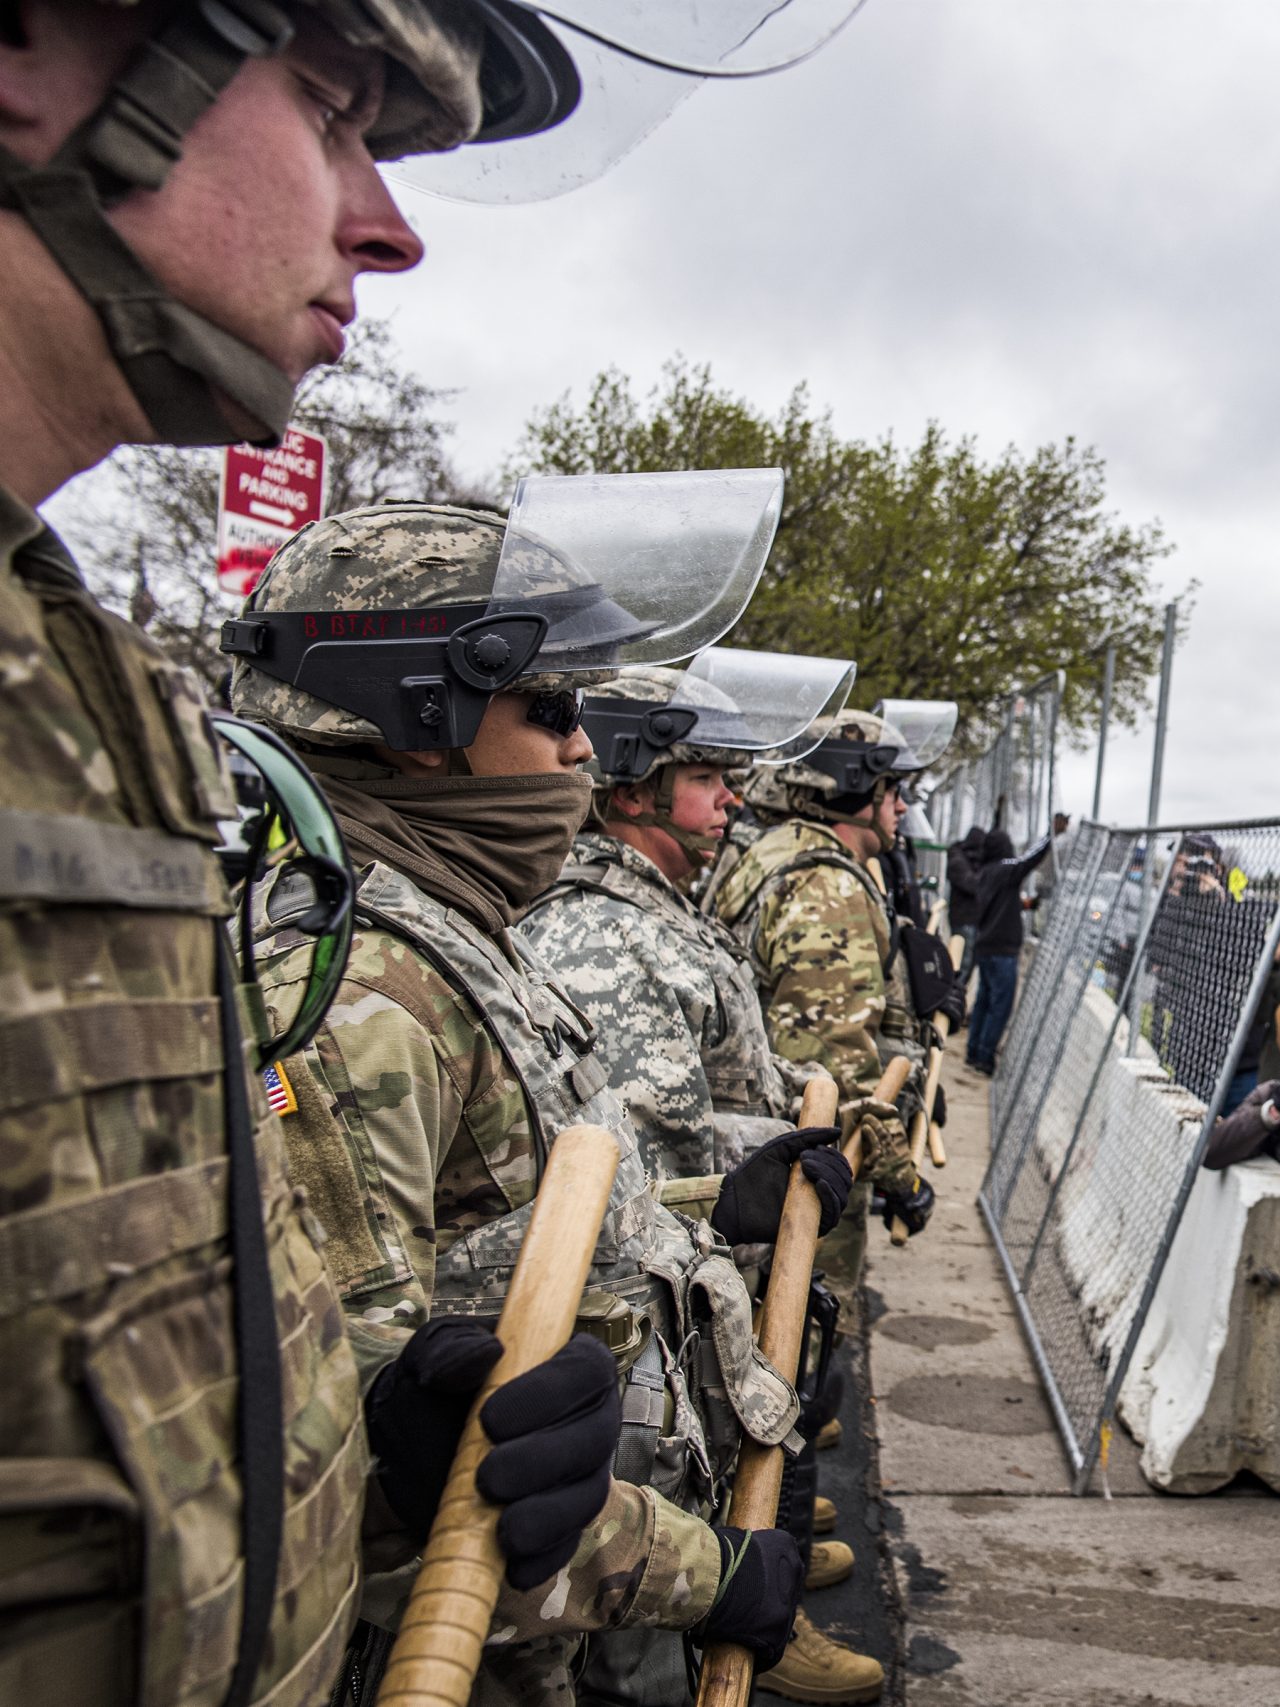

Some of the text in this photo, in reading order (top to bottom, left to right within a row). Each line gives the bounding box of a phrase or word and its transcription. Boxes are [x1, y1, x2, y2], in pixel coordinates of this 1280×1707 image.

[261, 464, 289, 485] AND
[239, 472, 308, 511] PARKING
[304, 614, 319, 638] B
